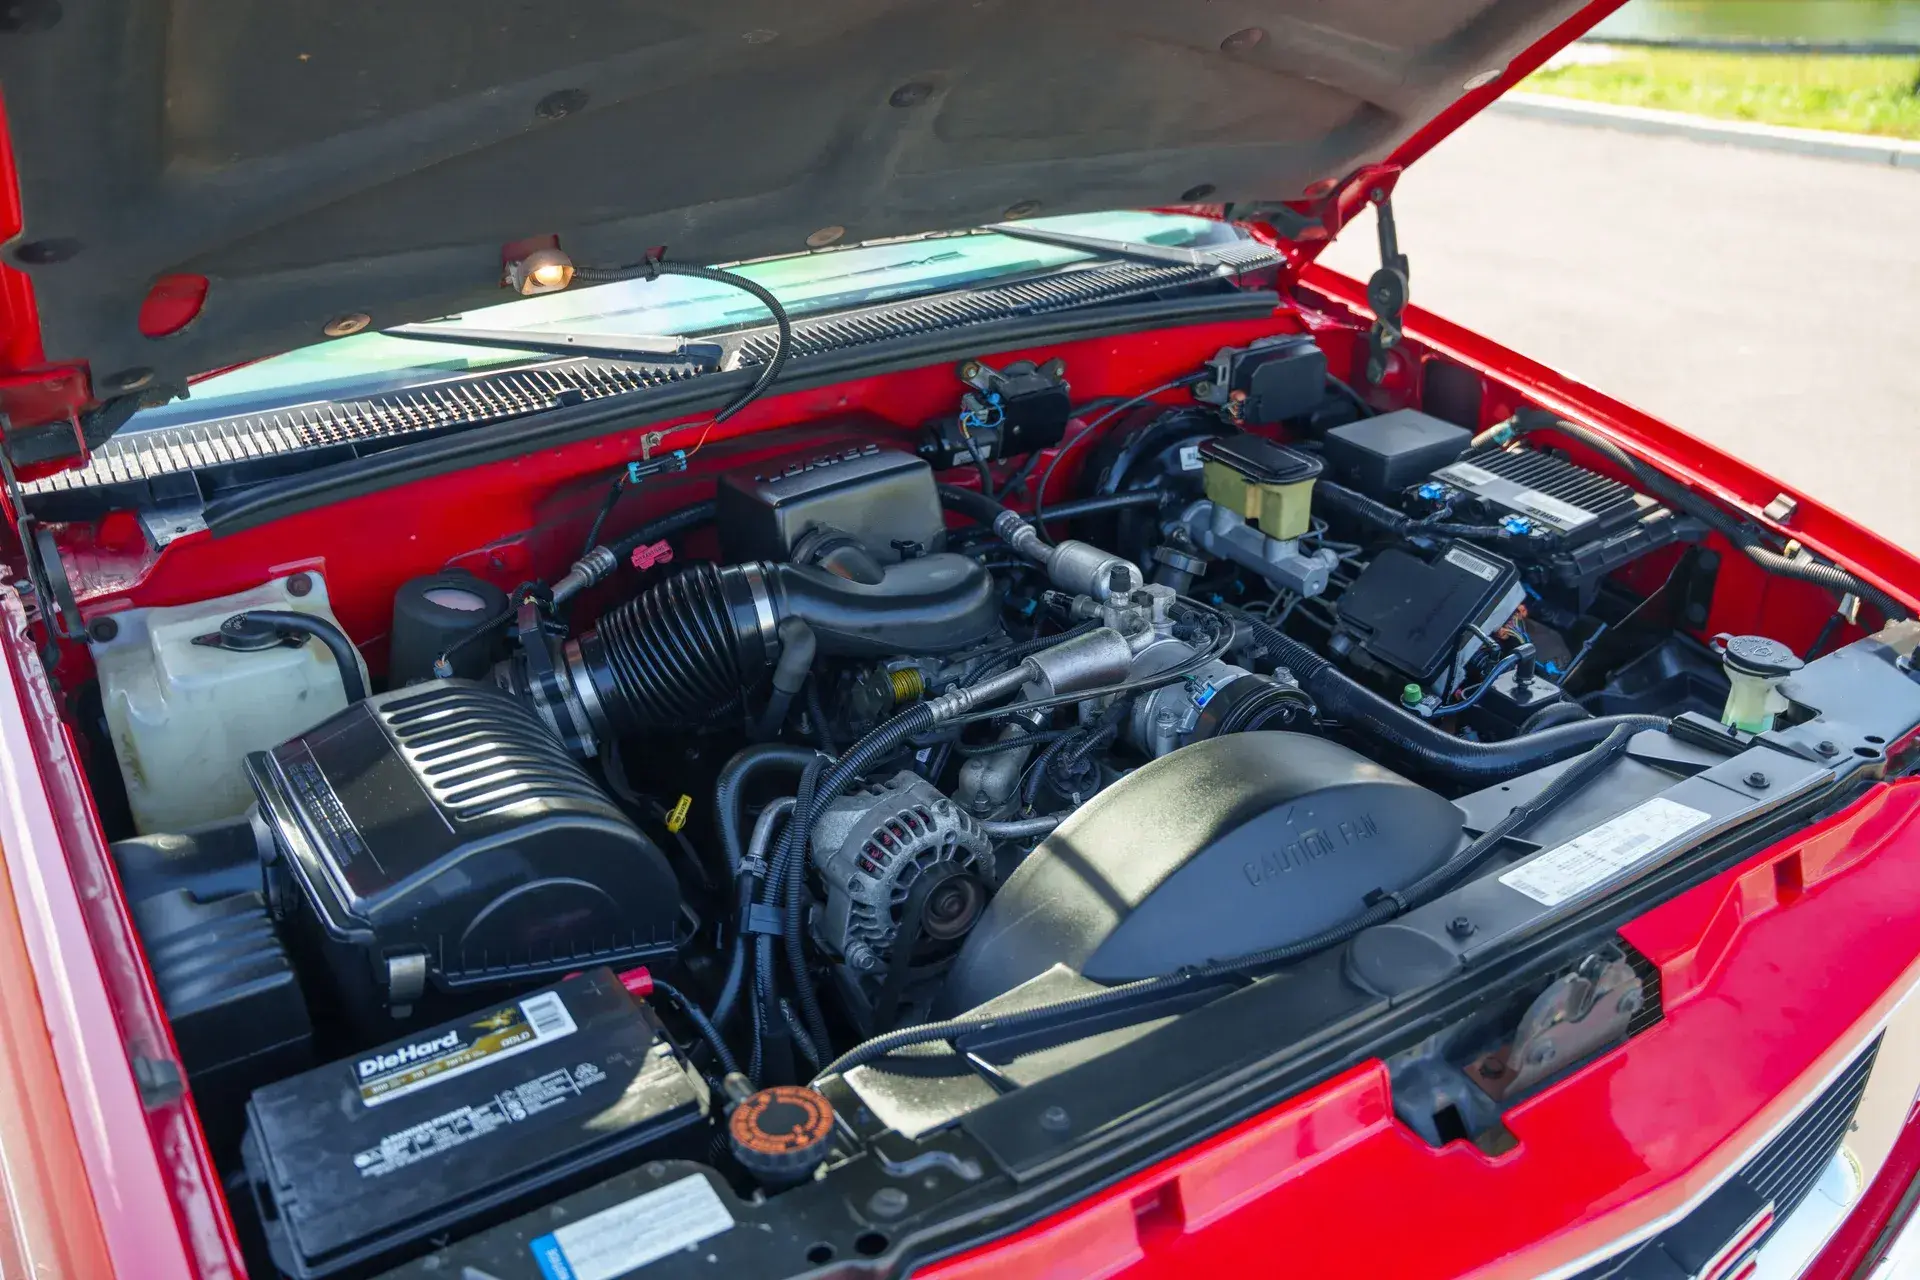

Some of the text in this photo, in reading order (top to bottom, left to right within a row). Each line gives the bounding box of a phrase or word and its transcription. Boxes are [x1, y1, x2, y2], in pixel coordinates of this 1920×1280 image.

[1242, 812, 1381, 888] CAUTION FAN
[358, 1029, 460, 1078] DieHard
[500, 1031, 531, 1048] GOLD
